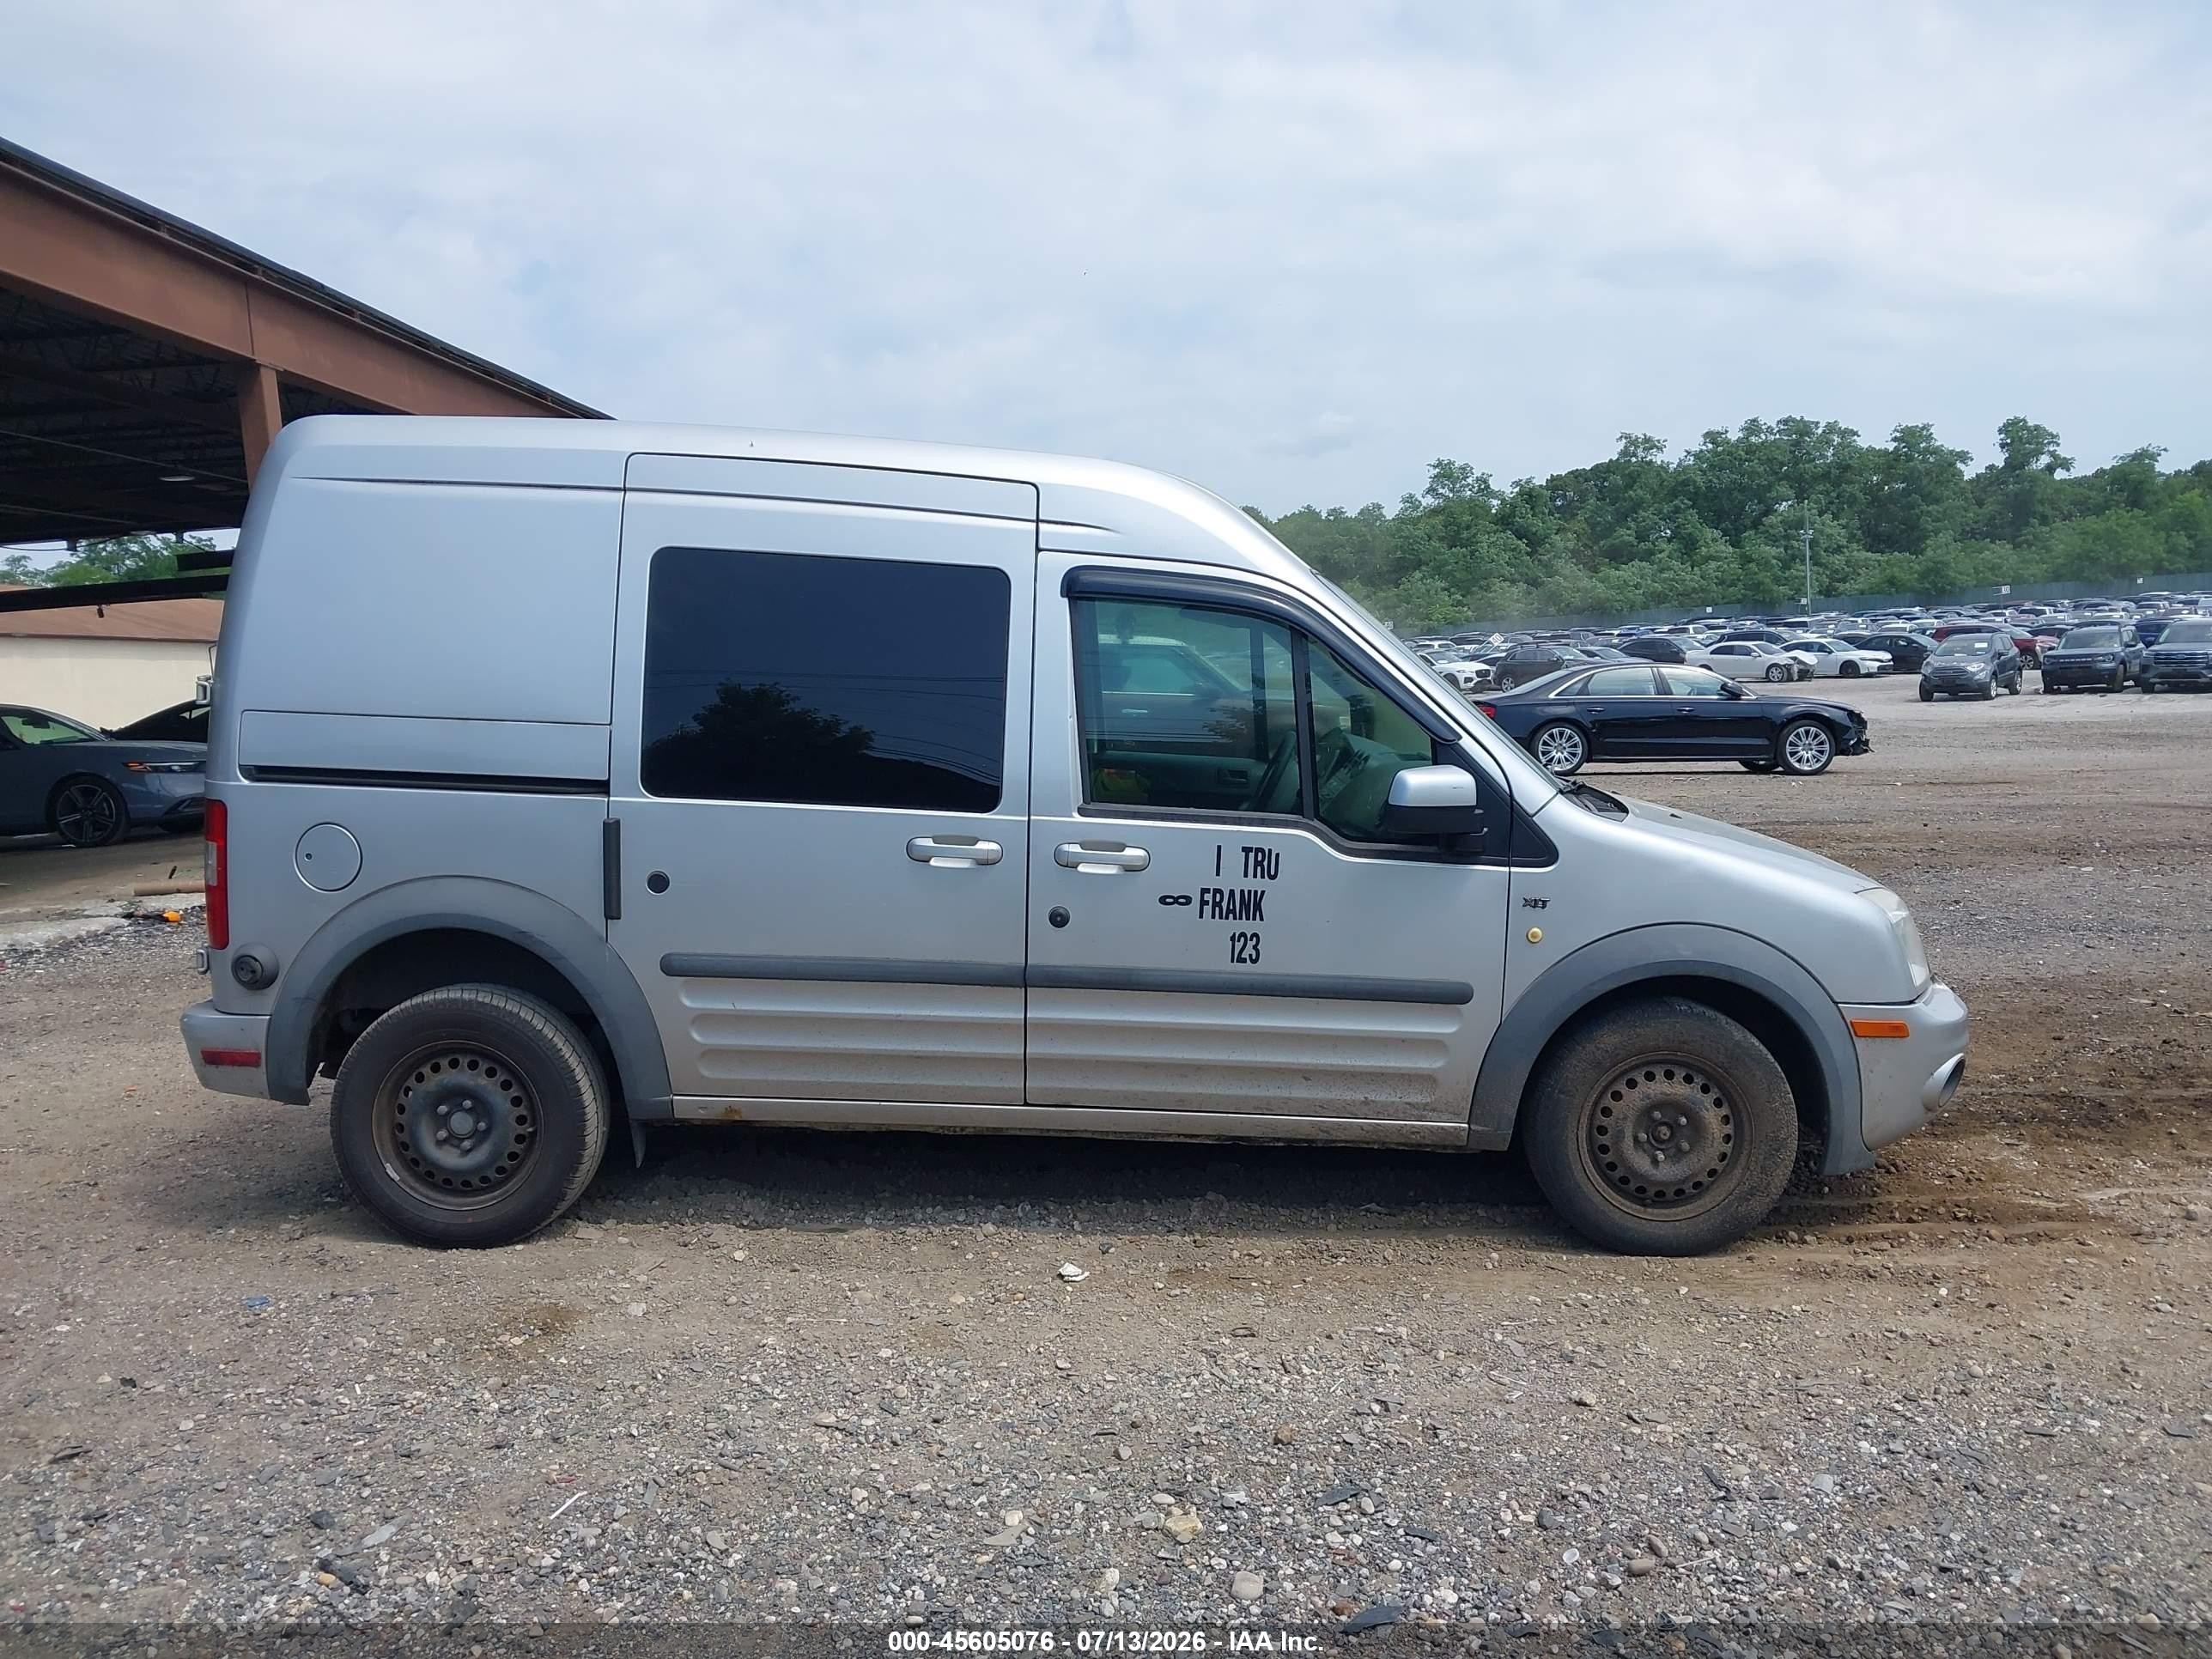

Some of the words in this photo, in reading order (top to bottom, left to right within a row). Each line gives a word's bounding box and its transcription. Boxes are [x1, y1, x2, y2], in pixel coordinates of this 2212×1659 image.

[1242, 846, 1279, 880] TRU
[1199, 887, 1266, 921] FRANK
[1230, 931, 1261, 964] 123
